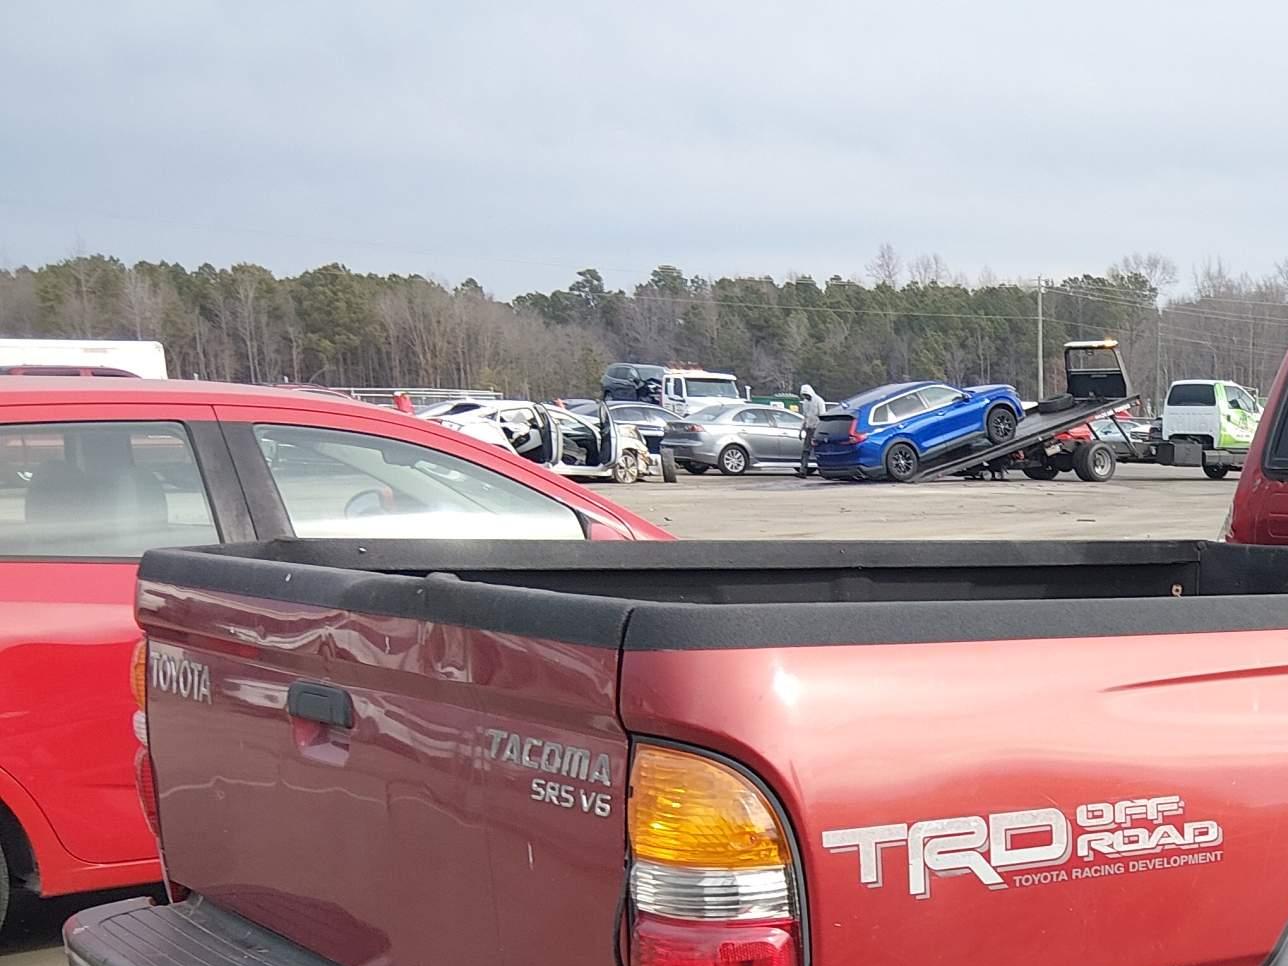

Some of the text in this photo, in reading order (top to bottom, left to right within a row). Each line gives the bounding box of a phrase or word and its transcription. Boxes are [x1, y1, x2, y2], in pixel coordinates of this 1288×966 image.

[150, 651, 212, 704] TOYOTA
[484, 727, 614, 788] TACOMA
[577, 791, 612, 819] V6
[1076, 795, 1185, 829] OFF
[821, 807, 1073, 900] TRD
[1076, 820, 1223, 859] ROAD
[1012, 849, 1224, 889] TOYOTA RACING DEVELOPMENT
